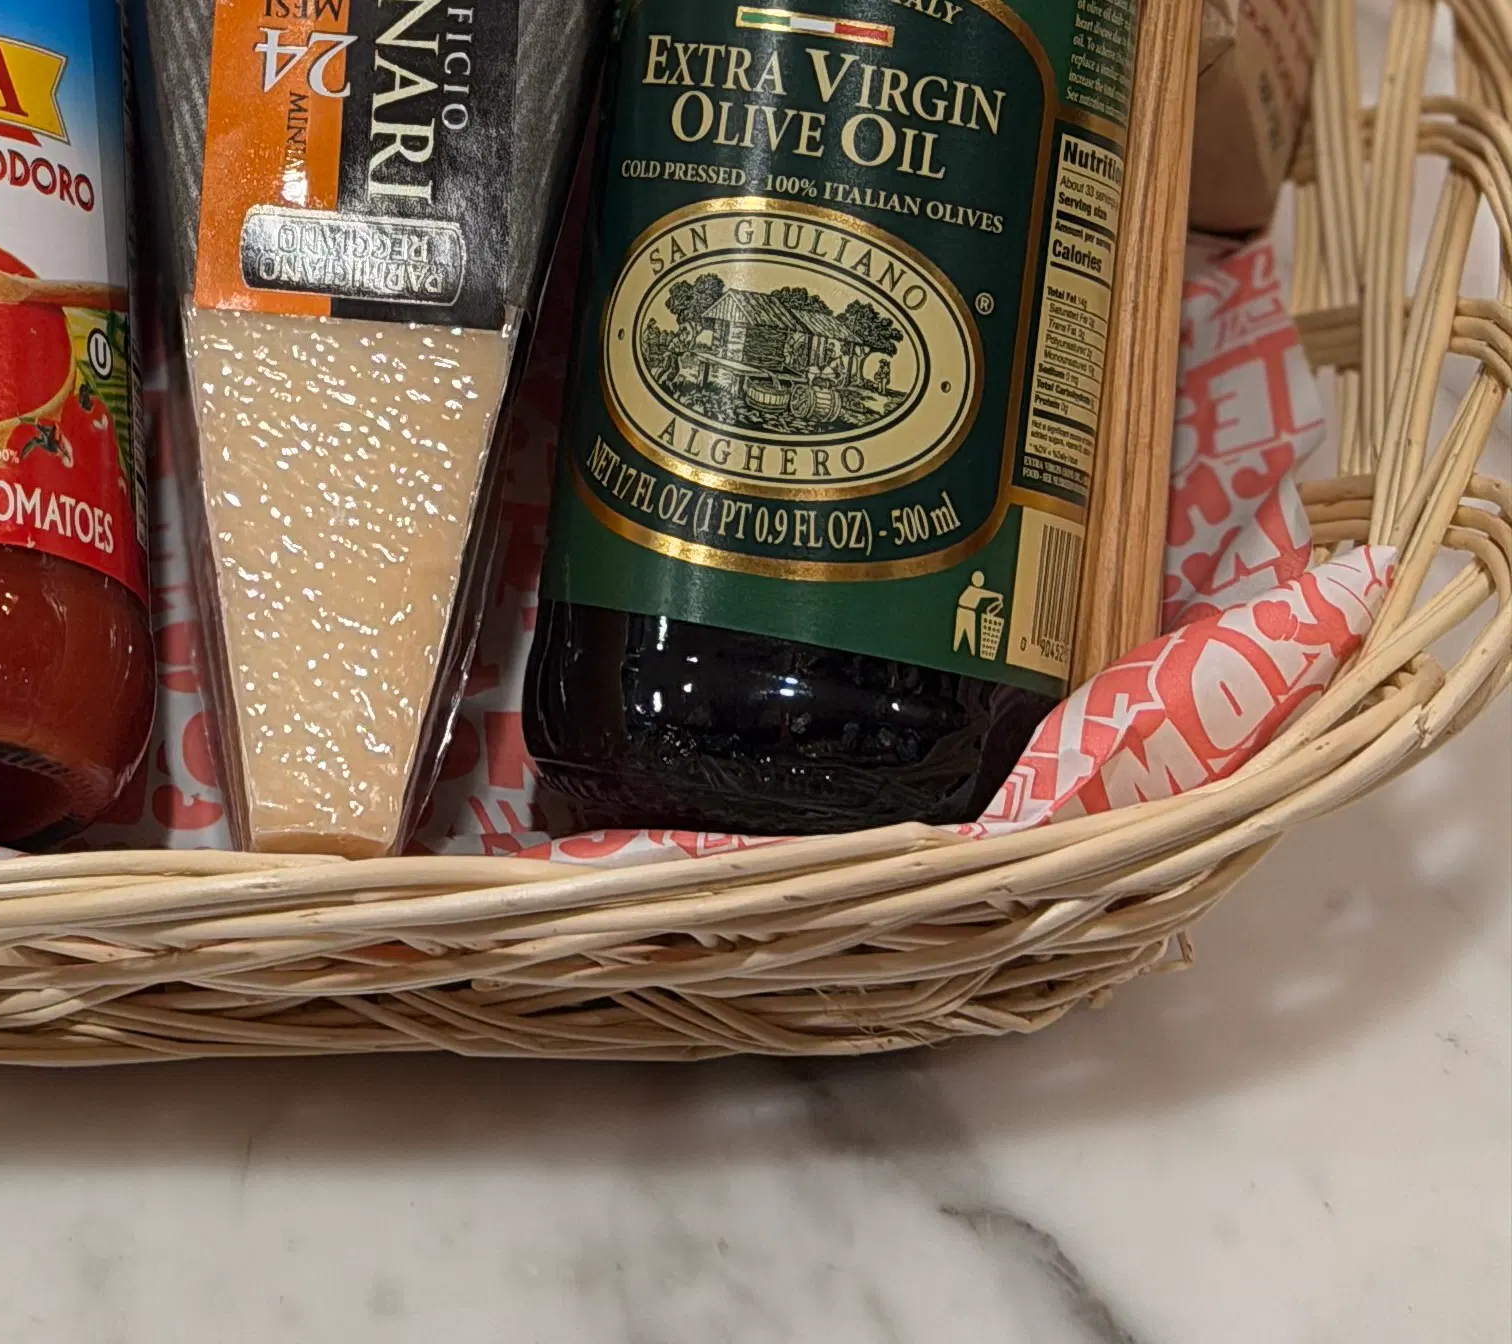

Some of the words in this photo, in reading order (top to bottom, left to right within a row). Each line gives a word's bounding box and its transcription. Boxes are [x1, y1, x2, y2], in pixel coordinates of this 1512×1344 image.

[254, 26, 359, 99] 24
[621, 159, 661, 179] COLD
[662, 161, 746, 187] PRESSED
[766, 173, 818, 198] 100%
[823, 181, 921, 217] ITALIAN
[926, 201, 1004, 234] OLIVES
[648, 223, 709, 276] SAN
[734, 220, 928, 312] GIULIANO
[1052, 239, 1102, 273] Calories
[656, 416, 866, 477] ALGHERO
[586, 434, 619, 482] NET
[617, 465, 636, 499] 17
[635, 473, 655, 515] FL
[657, 482, 692, 526] OZ
[718, 501, 754, 540] PT
[754, 509, 788, 546] 0.9
[793, 511, 822, 550] FL
[826, 507, 873, 557] OZ)
[891, 504, 928, 546] 500
[930, 490, 962, 536] ml
